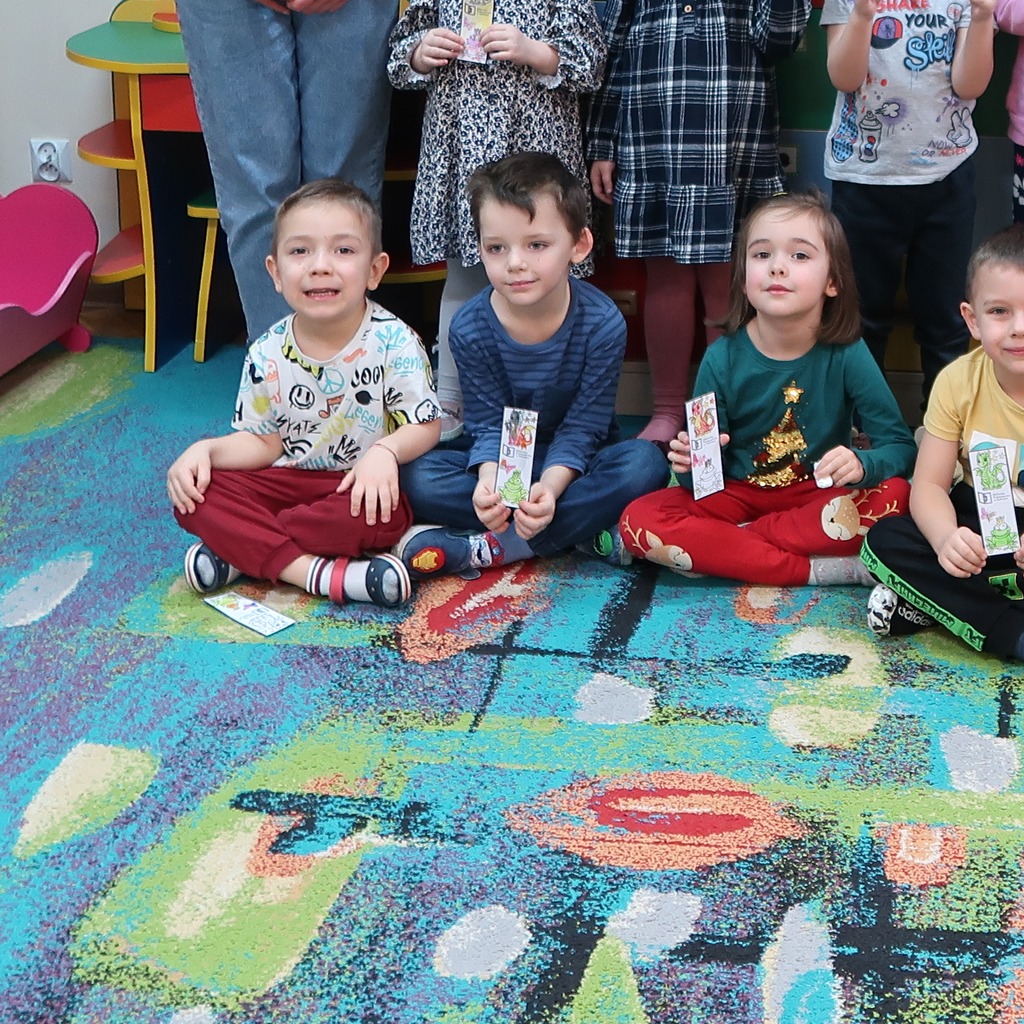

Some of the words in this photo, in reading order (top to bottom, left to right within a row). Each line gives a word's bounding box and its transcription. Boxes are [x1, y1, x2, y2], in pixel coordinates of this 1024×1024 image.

[904, 13, 949, 30] YOUR
[928, 139, 953, 149] NOW
[921, 149, 936, 157] OR
[897, 606, 934, 627] adidas
